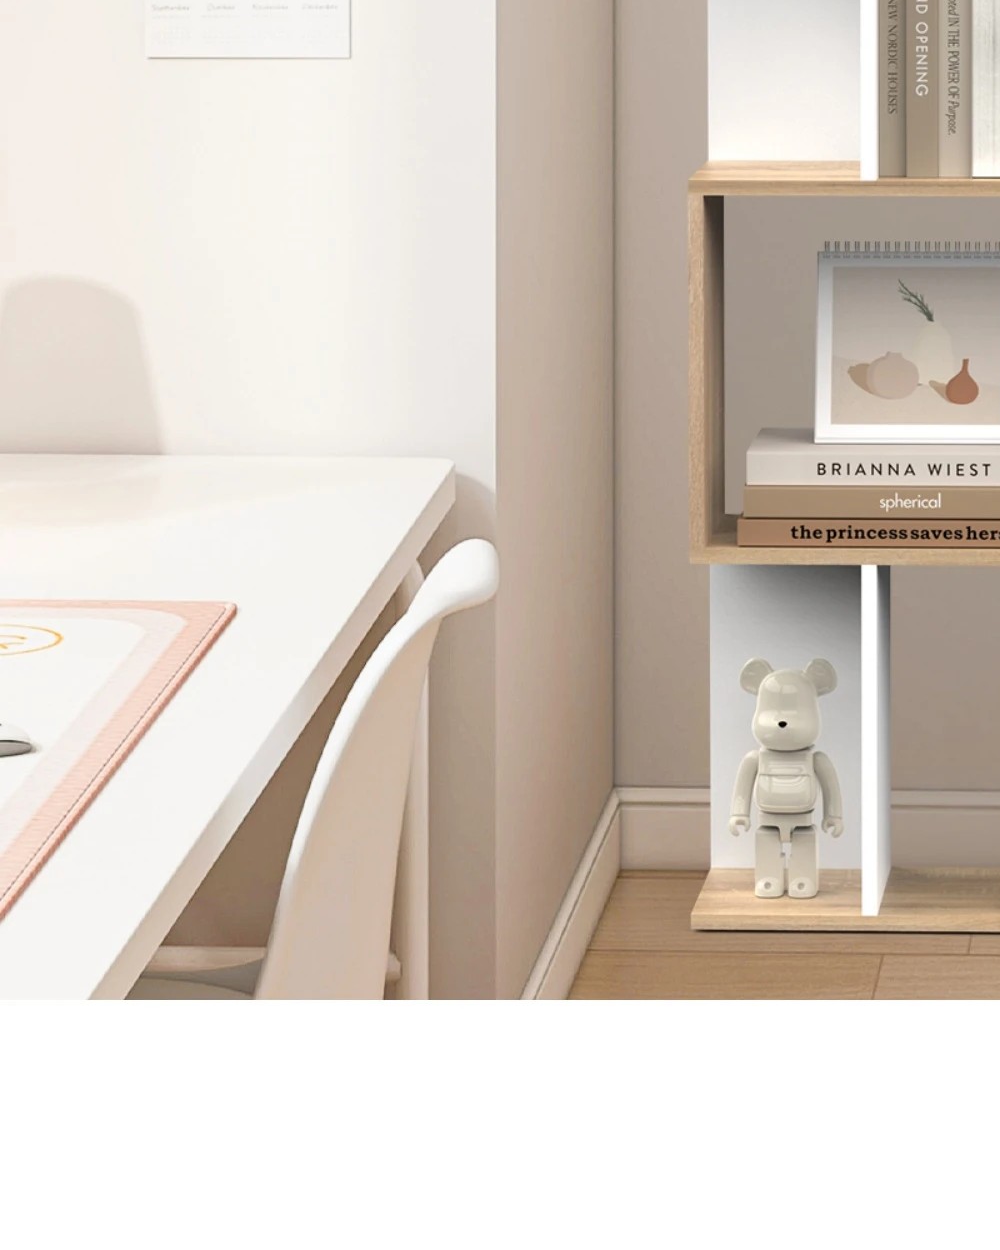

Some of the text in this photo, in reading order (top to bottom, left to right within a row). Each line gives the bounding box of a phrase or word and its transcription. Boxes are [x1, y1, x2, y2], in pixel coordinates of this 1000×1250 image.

[947, 16, 961, 27] IN
[887, 24, 898, 65] NORDIC
[947, 30, 961, 48] THE
[915, 21, 929, 97] OPENING
[947, 50, 961, 84] POWER
[887, 72, 898, 116] HOUSES
[947, 84, 961, 99] OF
[816, 462, 992, 477] BRIANNA WIEST
[879, 492, 942, 513] spherical
[790, 524, 823, 541] the
[825, 524, 909, 544] princess
[910, 527, 964, 541] saves
